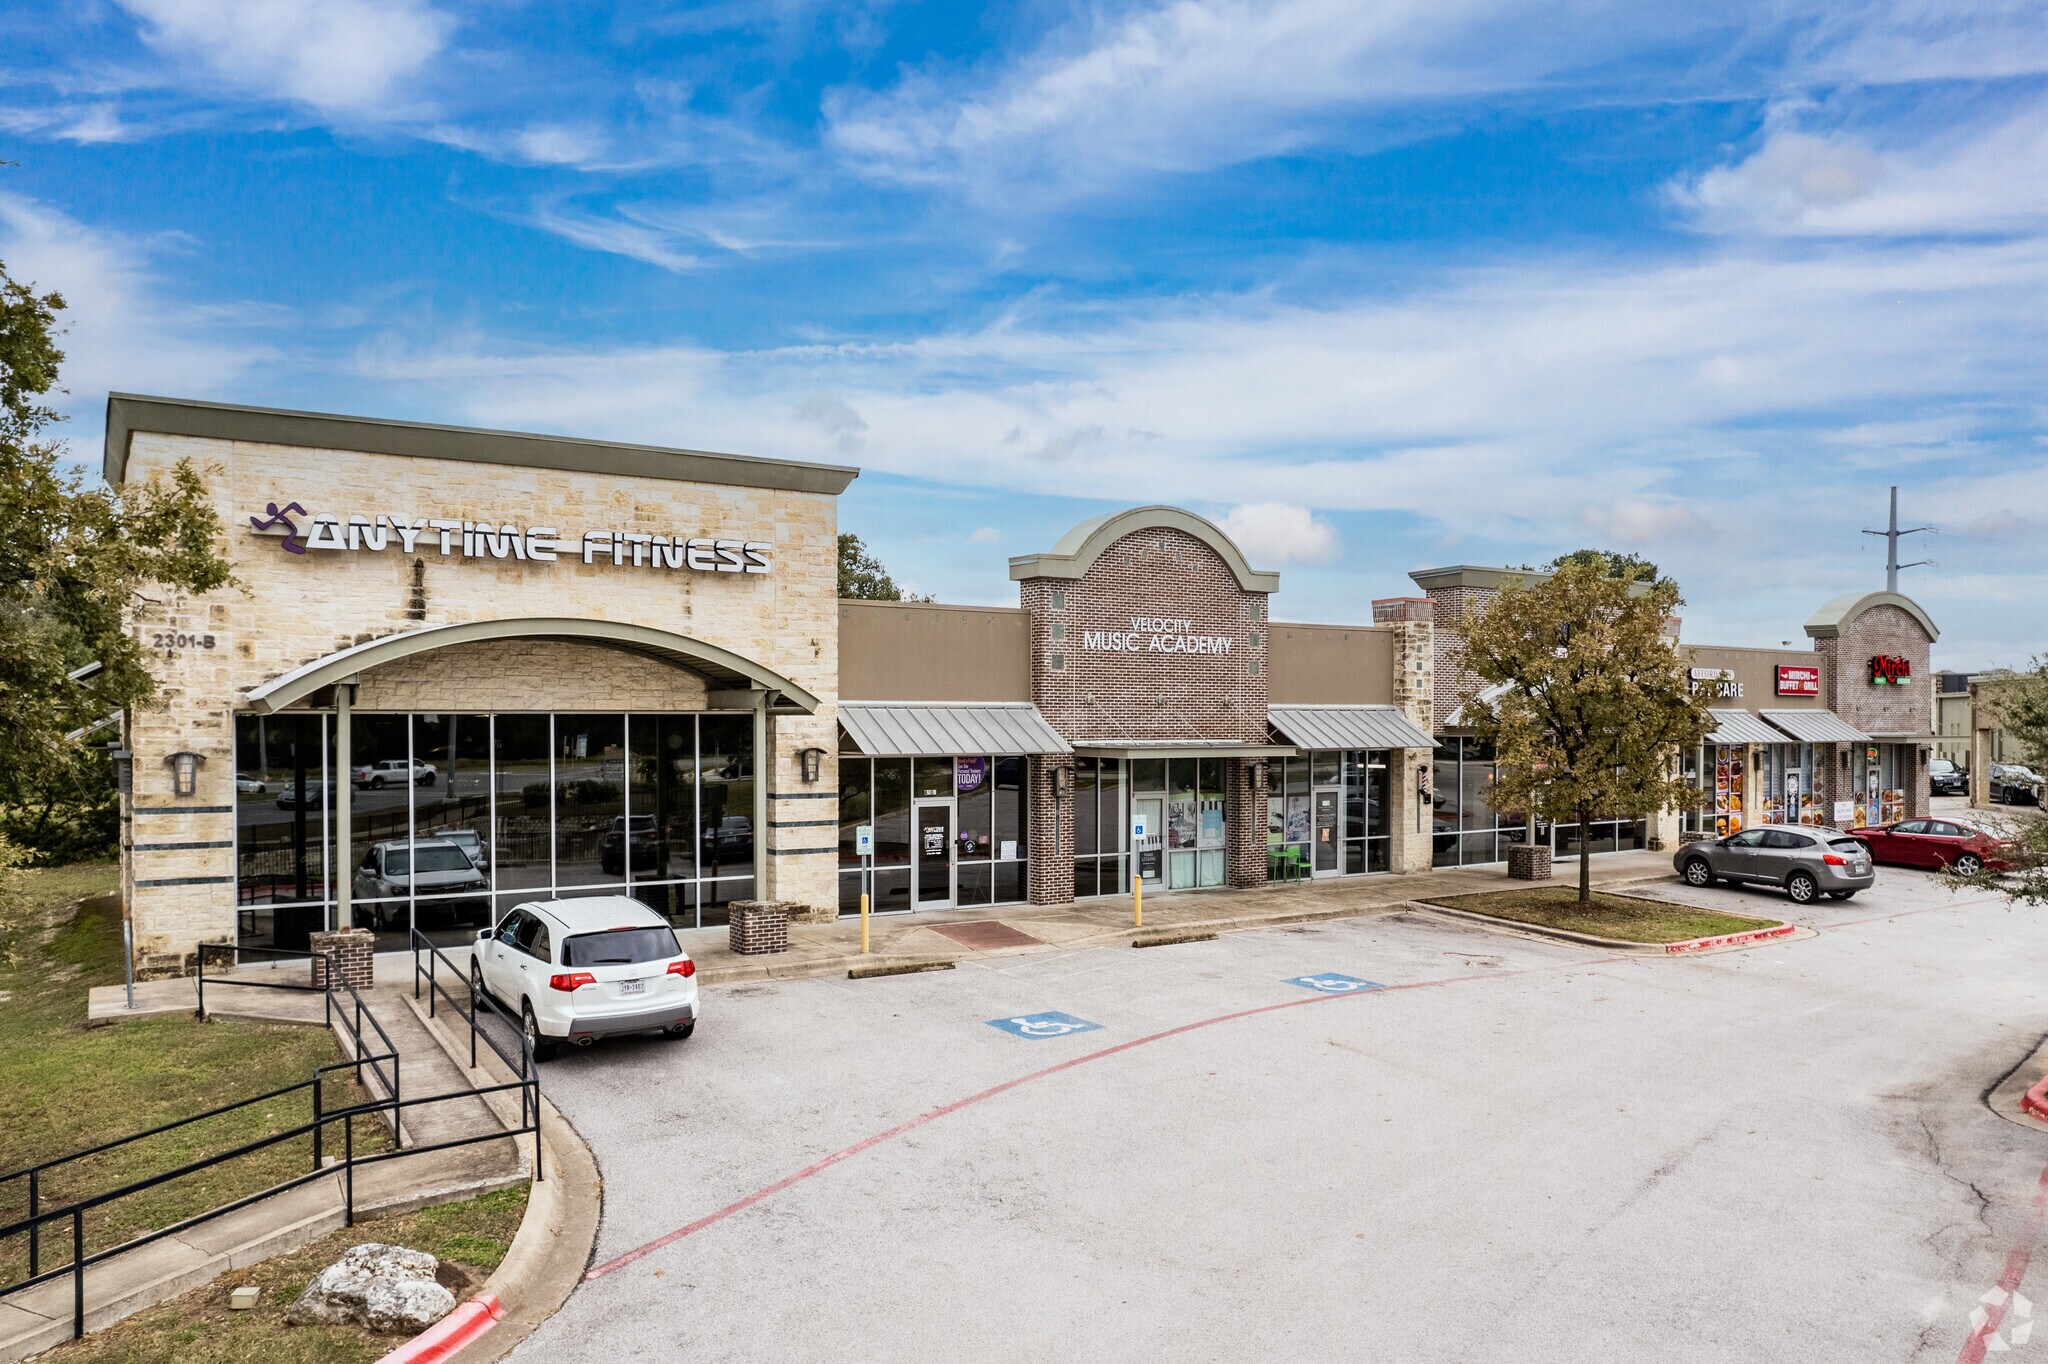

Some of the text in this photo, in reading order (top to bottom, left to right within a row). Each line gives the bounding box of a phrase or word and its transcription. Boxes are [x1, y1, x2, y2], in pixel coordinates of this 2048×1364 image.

[305, 512, 773, 574] ANYTIME FITNESS
[1131, 617, 1192, 633] VELOCITY
[153, 633, 216, 649] 2301-B
[1084, 631, 1232, 654] MUSIC ACADEMY
[1788, 670, 1811, 680] MIRCHI
[1716, 682, 1744, 698] CARE
[1780, 680, 1799, 690] BUFFET
[1804, 681, 1818, 691] GRILL
[958, 774, 981, 784] TODAY!
